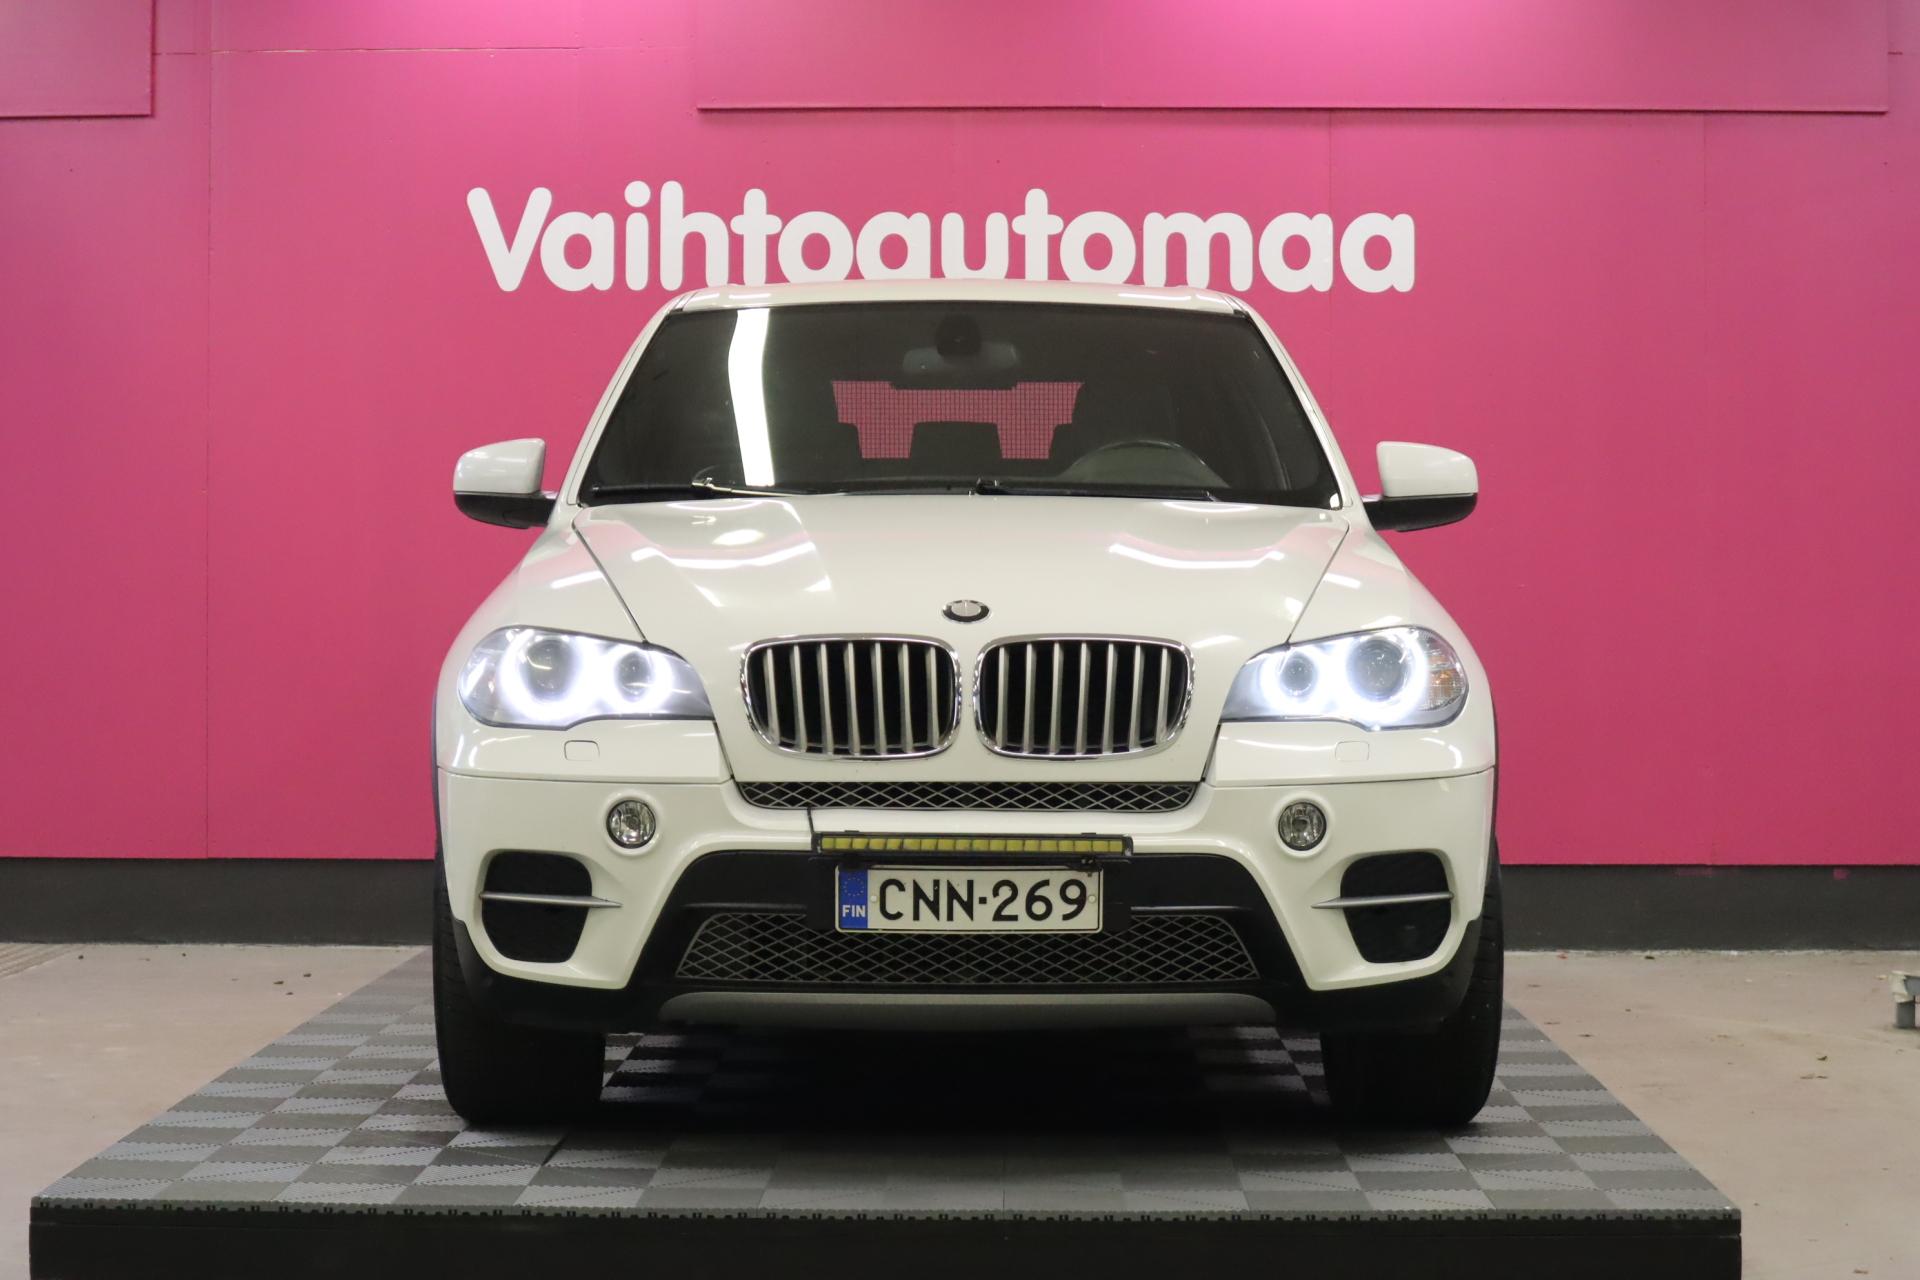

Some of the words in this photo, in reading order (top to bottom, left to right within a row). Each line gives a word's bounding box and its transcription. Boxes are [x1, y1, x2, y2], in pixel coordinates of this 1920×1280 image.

[466, 180, 1416, 293] Vaihtoautomaa
[842, 904, 866, 917] FIN
[879, 878, 1087, 922] CNN-269
